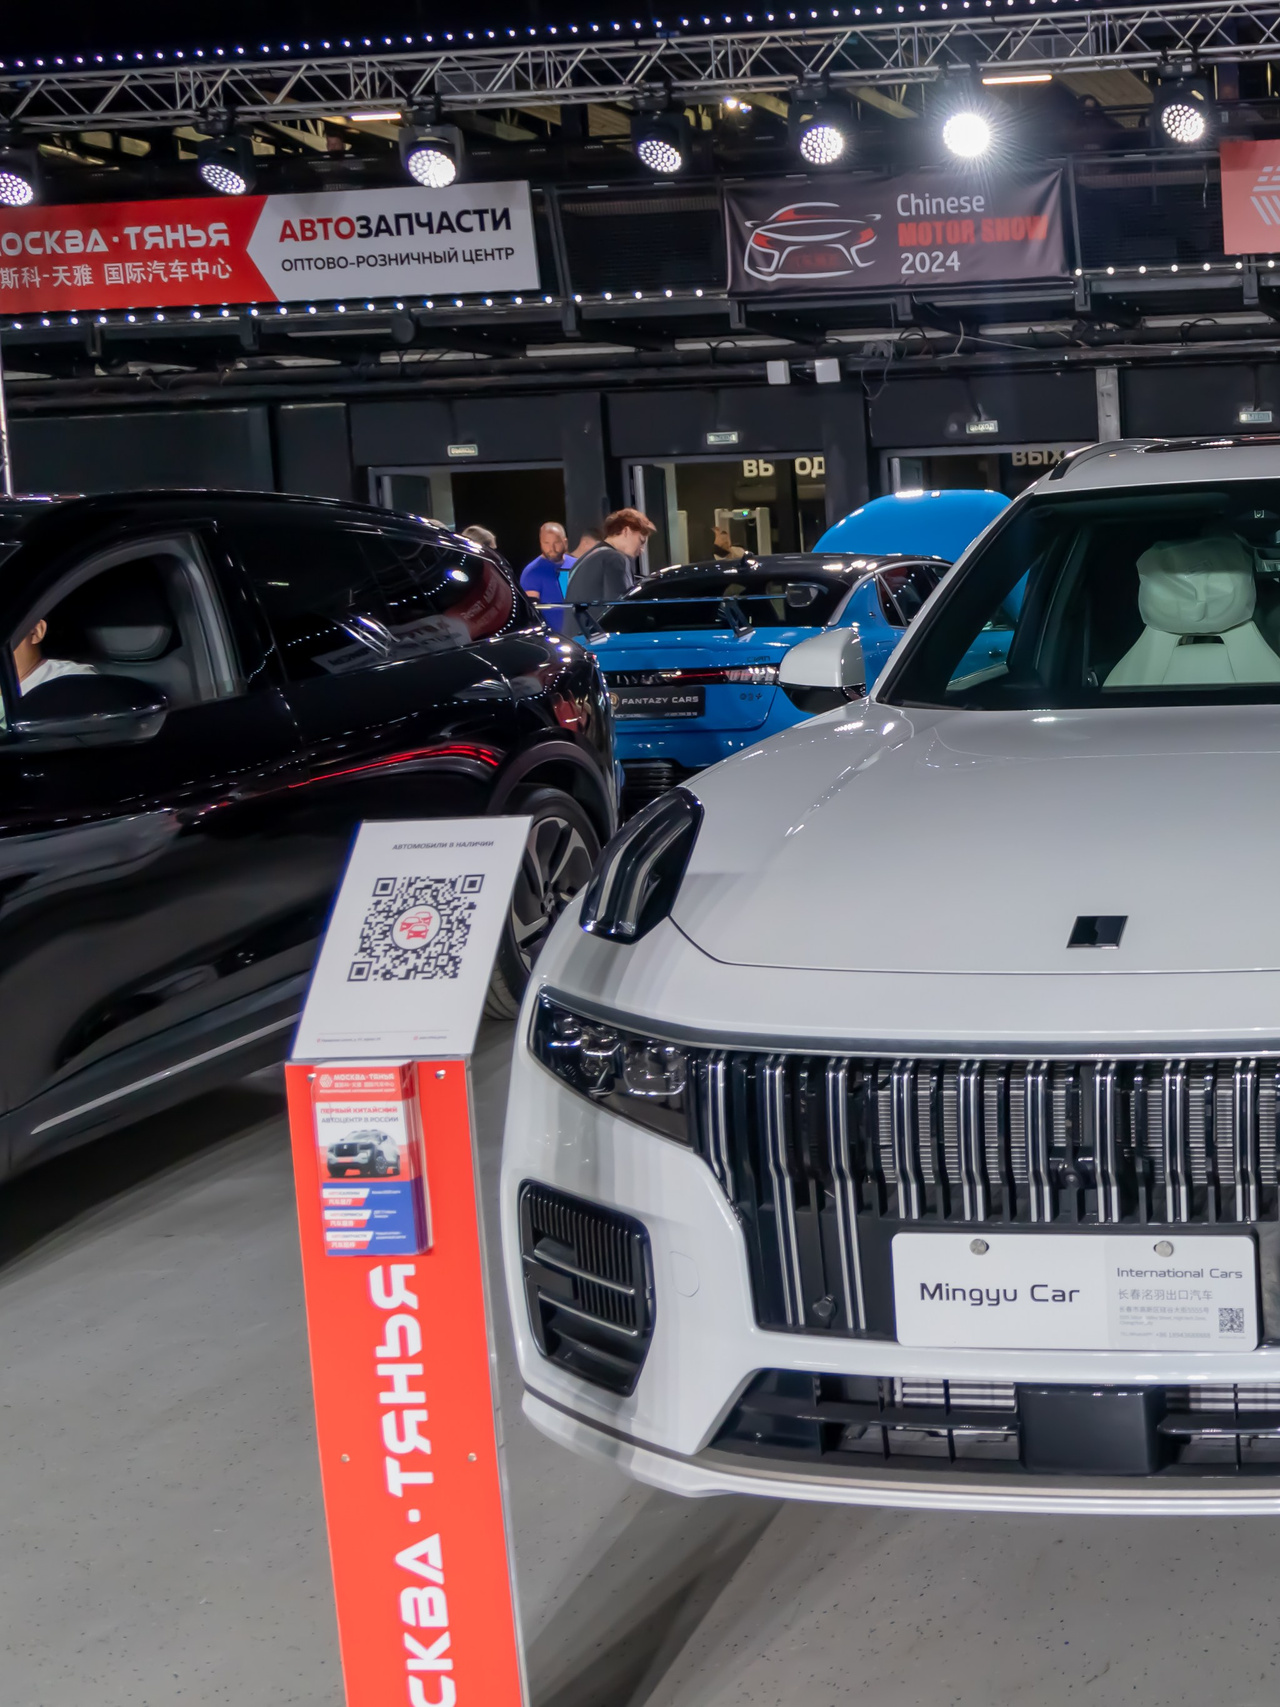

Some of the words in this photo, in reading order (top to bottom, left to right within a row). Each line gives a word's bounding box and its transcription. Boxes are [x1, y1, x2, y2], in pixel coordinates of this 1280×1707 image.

[897, 193, 985, 216] Chinese
[278, 207, 512, 243] АВТОЗАПЧАСТИ
[898, 219, 975, 247] MOTOR
[981, 214, 1048, 243] SHOW
[0, 228, 109, 257] ОСКВА
[123, 222, 230, 251] ТЯНЬЯ
[281, 246, 459, 272] ОПТОВО-РОЗНИЧНЫЙ
[461, 246, 515, 264] ЦЕНТР
[901, 251, 961, 274] 2024
[104, 258, 233, 286] 国际汽车中心
[621, 697, 668, 705] FANTAZY
[392, 842, 448, 850] АВТОМОБИЛИ
[455, 840, 495, 848] НАЛИЧИИ
[320, 1106, 351, 1114] ПЕРВЫЙ
[1116, 1267, 1204, 1279] International
[1209, 1268, 1243, 1280] Cars
[920, 1282, 1018, 1307] Mingyu
[1030, 1283, 1080, 1303] Car
[368, 1263, 435, 1498] ТЯНЬЯ
